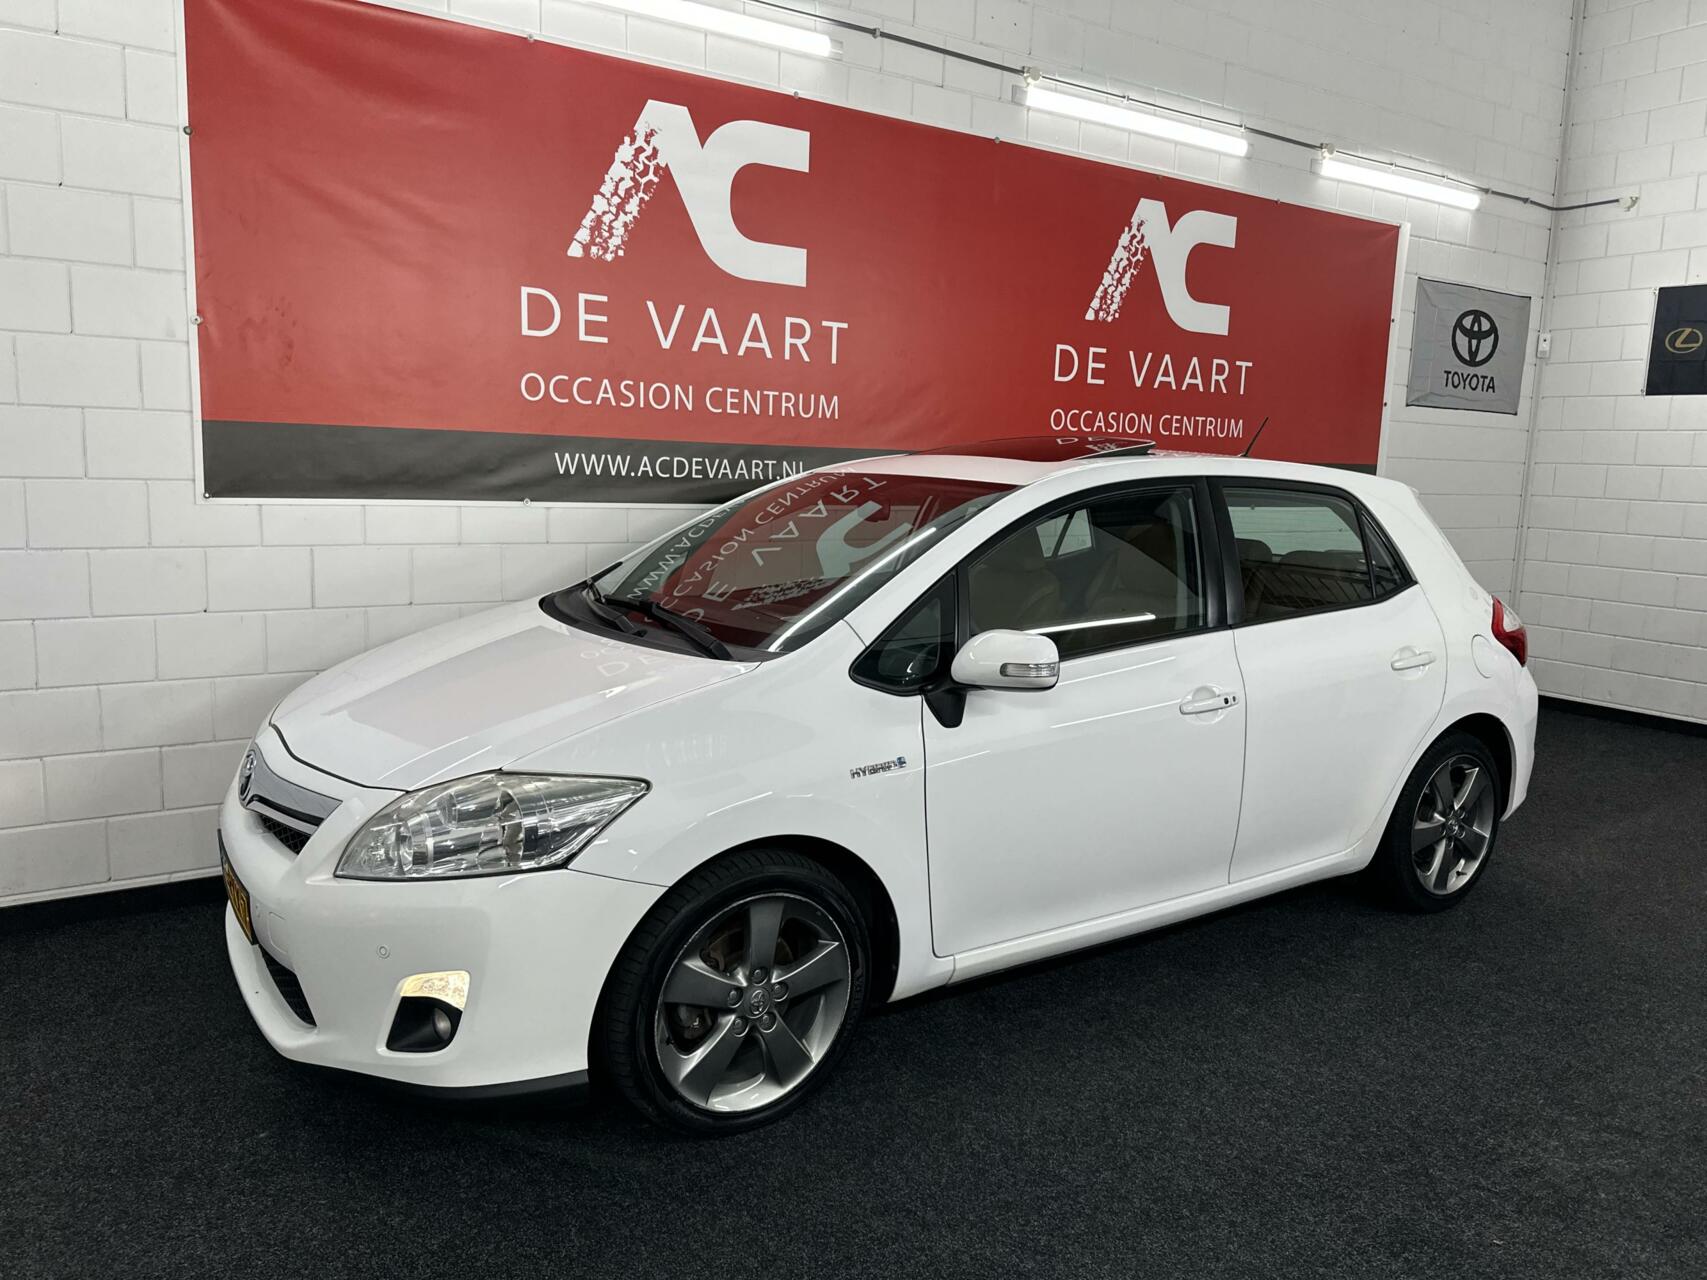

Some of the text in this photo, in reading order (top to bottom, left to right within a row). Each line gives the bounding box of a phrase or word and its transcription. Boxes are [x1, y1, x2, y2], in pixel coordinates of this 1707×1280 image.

[567, 99, 810, 288] AC
[1085, 197, 1238, 336] AC
[520, 286, 848, 364] DE VAART
[1054, 343, 1253, 395] DE VAART
[1443, 369, 1496, 394] TOYOTA
[520, 372, 839, 419] OCCASION CENTRUM
[1050, 408, 1243, 439] OCCASION CENTRUM
